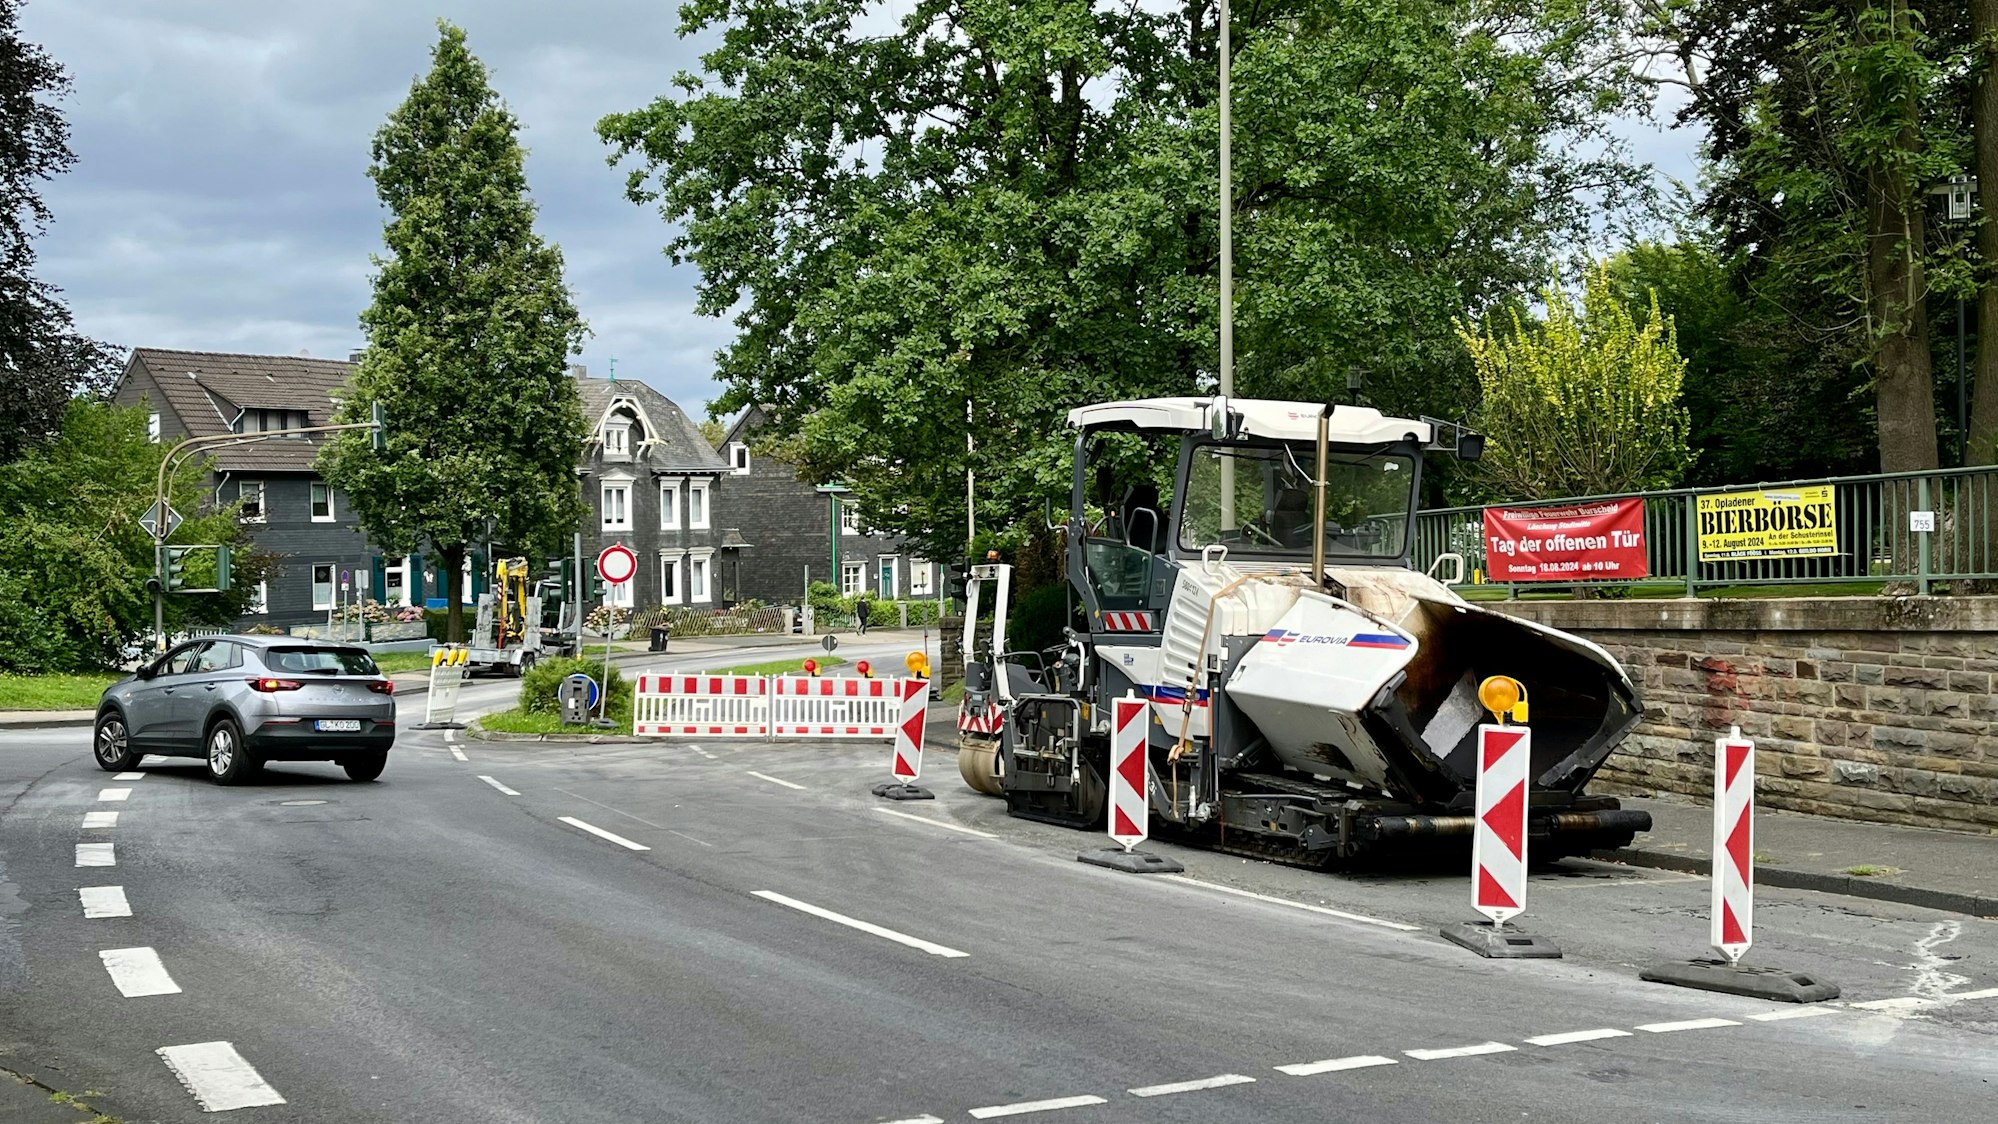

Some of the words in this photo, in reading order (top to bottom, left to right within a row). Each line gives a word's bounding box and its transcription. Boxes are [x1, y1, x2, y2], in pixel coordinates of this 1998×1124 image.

[1700, 500, 1714, 509] 37.
[1715, 498, 1756, 510] Opladener
[1502, 510, 1539, 520] Freiwillige
[1539, 508, 1578, 519] Feuerwehr
[1579, 503, 1619, 516] Burscheid
[1700, 500, 1833, 535] BIERBÖRSE
[1914, 519, 1930, 530] 755
[1778, 532, 1789, 540] der
[1790, 530, 1833, 540] Schusterinsel
[1490, 536, 1516, 556] Tag
[1520, 536, 1542, 552] der
[1545, 534, 1607, 551] offenen
[1611, 530, 1640, 548] Tür
[1724, 538, 1747, 549] August
[1747, 537, 1764, 547] 2024
[1508, 564, 1537, 574] Sonntag
[1539, 562, 1579, 573] 18.08.2024
[1582, 562, 1592, 571] ab
[1593, 561, 1604, 571] 10
[1605, 561, 1620, 571] Uhr
[1299, 635, 1348, 645] EUROVIA
